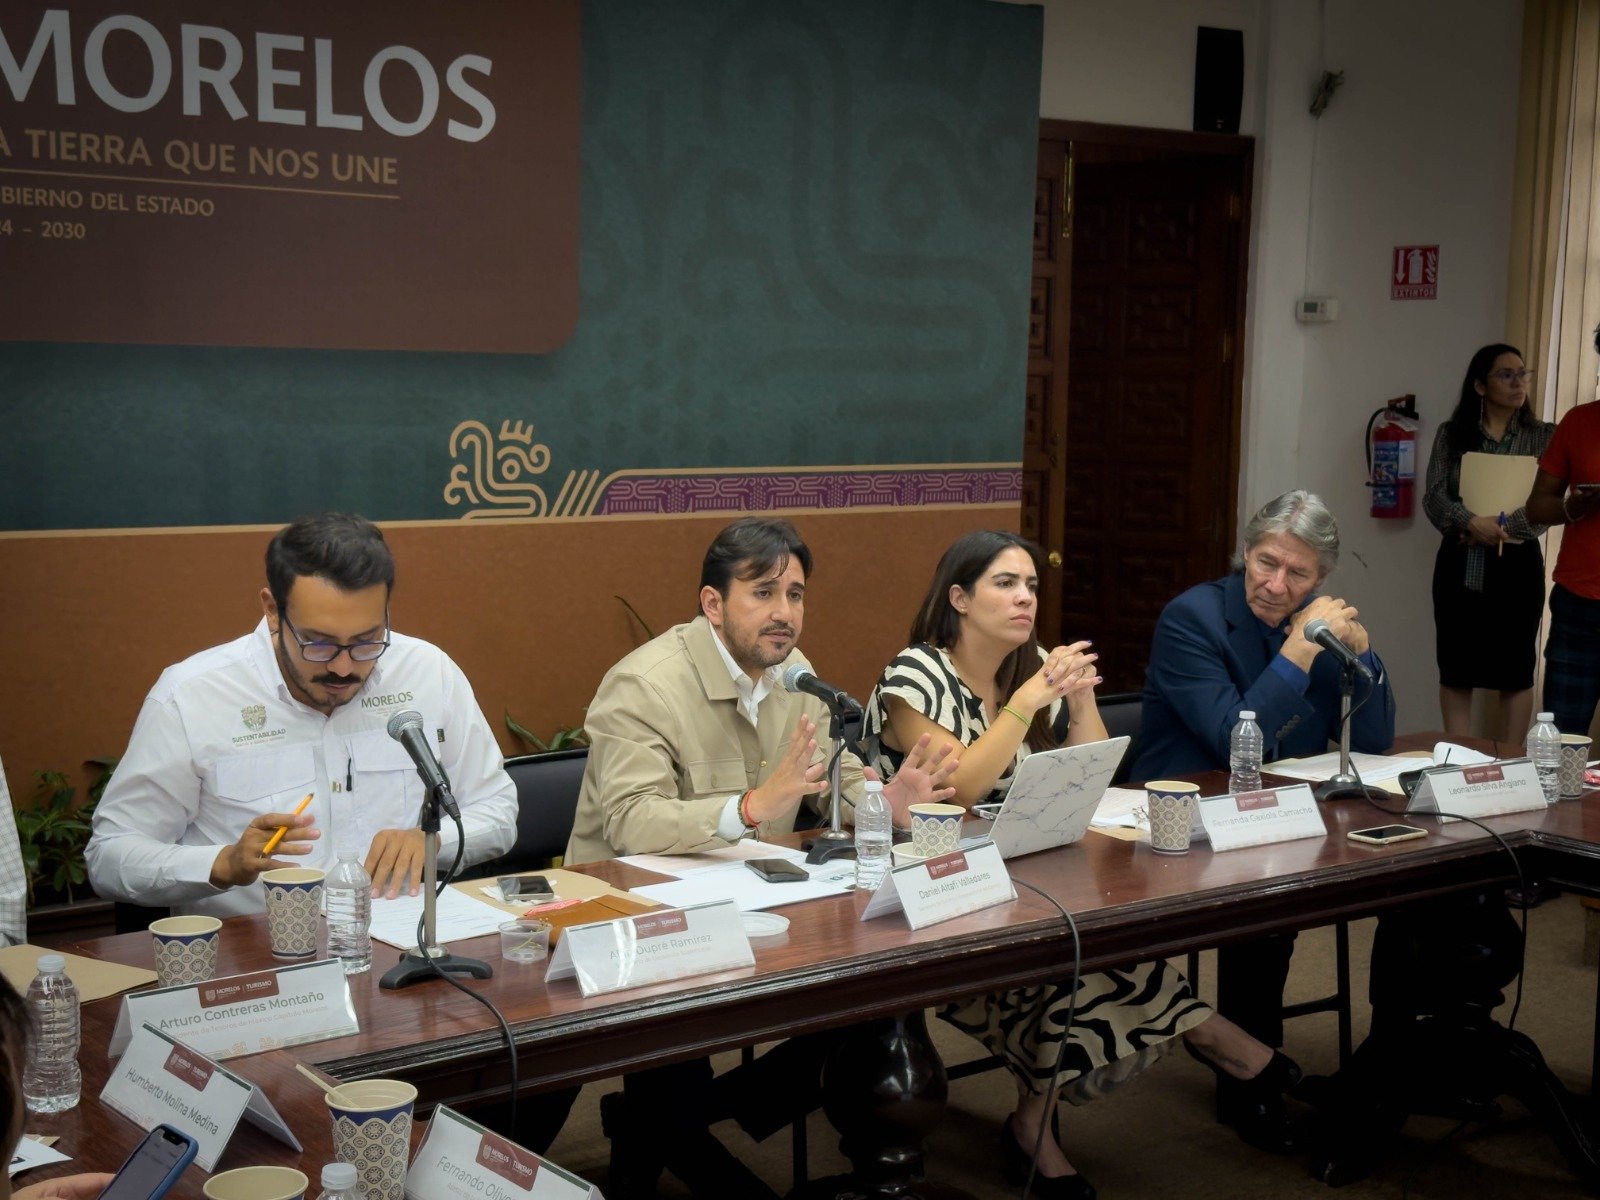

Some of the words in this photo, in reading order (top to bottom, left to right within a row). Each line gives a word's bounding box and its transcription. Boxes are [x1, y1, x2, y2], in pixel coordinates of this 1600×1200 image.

[0, 9, 497, 143] MORELOS
[25, 128, 152, 167] TIERRA
[163, 139, 236, 174] QUE
[249, 146, 319, 179] NOS
[331, 152, 399, 184] UNE
[91, 191, 129, 211] DEL
[136, 194, 215, 217] ESTADO
[0, 219, 13, 236] 4
[41, 220, 86, 239] 2030
[1393, 288, 1434, 298] EXTINTOR
[361, 691, 413, 709] MORELOS
[231, 728, 286, 744] SUSTENTABILIDAD
[1448, 785, 1481, 795] Leonardo
[1481, 782, 1498, 791] Silva
[1212, 815, 1249, 828] Fernanda
[1249, 811, 1277, 822] Gaxiola
[1278, 806, 1313, 818] Camacho
[919, 886, 940, 899] Daniel
[959, 872, 991, 887] Valladares
[216, 985, 241, 994] MORELOS
[246, 980, 272, 989] TURISMO
[159, 1015, 201, 1030] Arturo
[204, 1002, 267, 1021] Contreras
[269, 992, 324, 1010] Montaño
[125, 1067, 162, 1099] Humberto
[162, 1090, 189, 1116] Molina
[188, 1107, 219, 1135] Medina
[437, 1155, 485, 1191] Fernando
[513, 1160, 533, 1175] TURISMO
